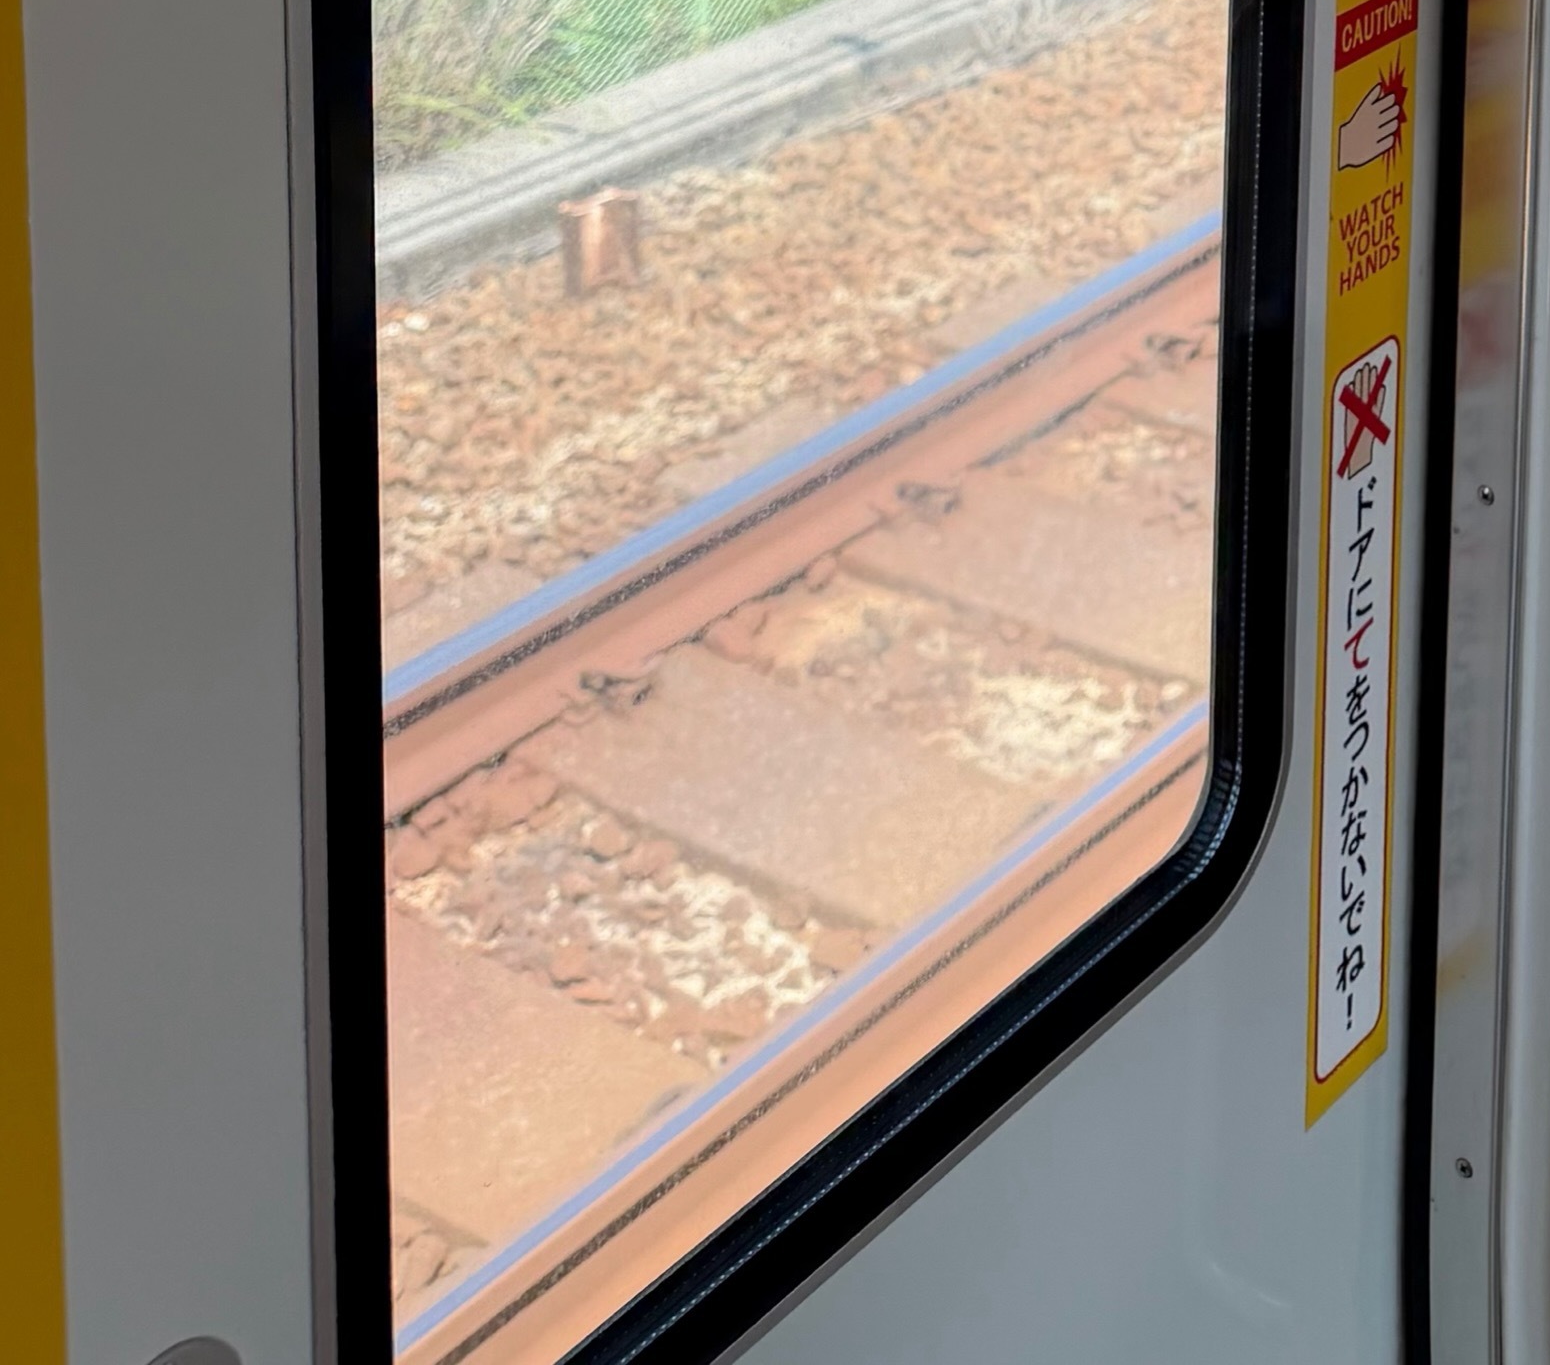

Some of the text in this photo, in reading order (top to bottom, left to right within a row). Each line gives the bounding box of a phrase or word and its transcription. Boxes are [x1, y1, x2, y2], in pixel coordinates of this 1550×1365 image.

[1339, 182, 1404, 241] WATCH
[1345, 214, 1395, 264] YOUR
[1339, 236, 1401, 296] HANDS
